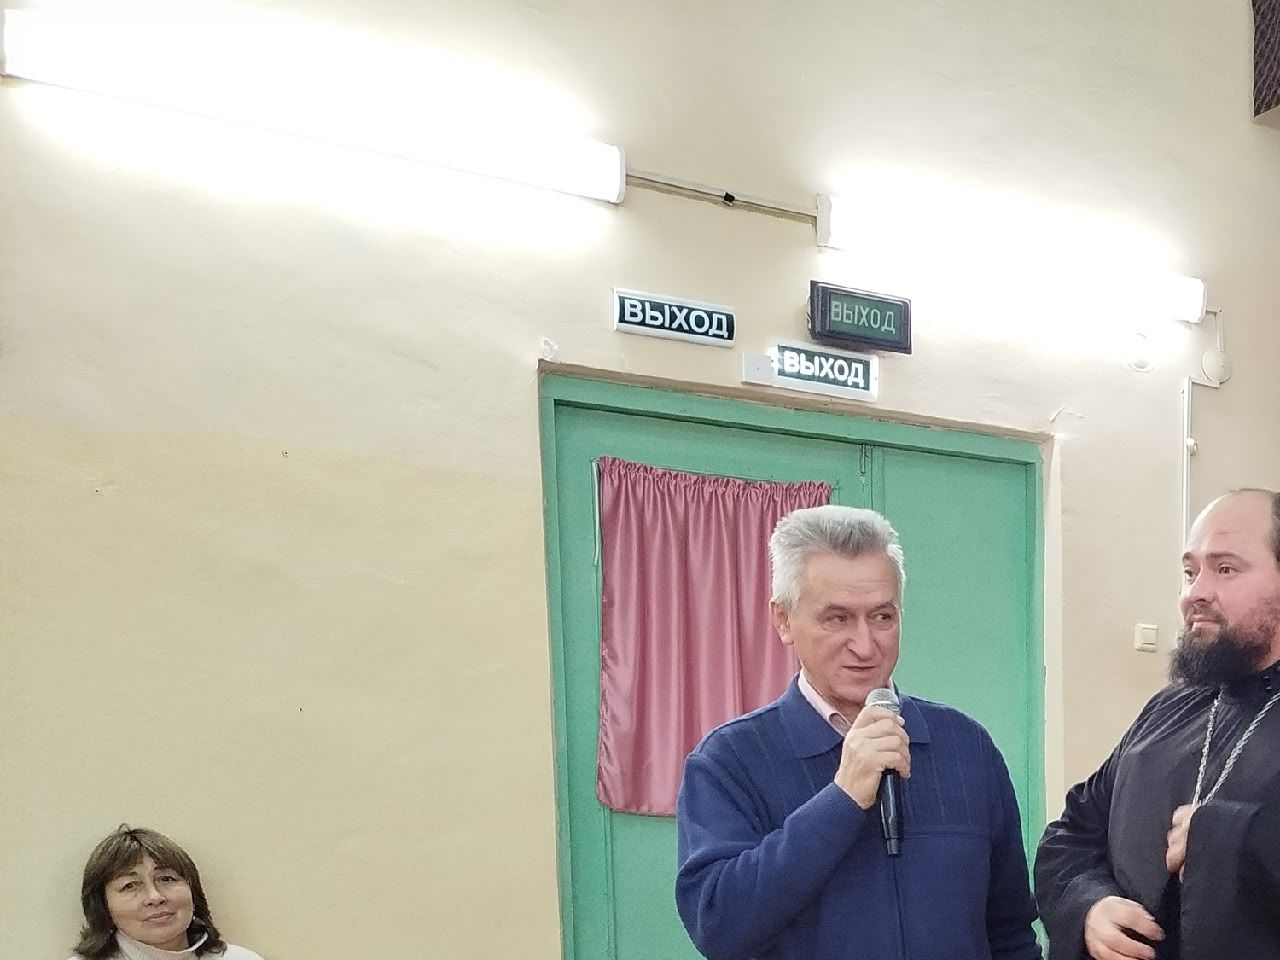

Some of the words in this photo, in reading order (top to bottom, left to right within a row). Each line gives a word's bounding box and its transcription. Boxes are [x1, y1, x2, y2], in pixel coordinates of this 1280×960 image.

[624, 299, 729, 339] ВЫХОД
[830, 300, 896, 334] ВЫХОД
[783, 350, 865, 387] ВЫХОД
